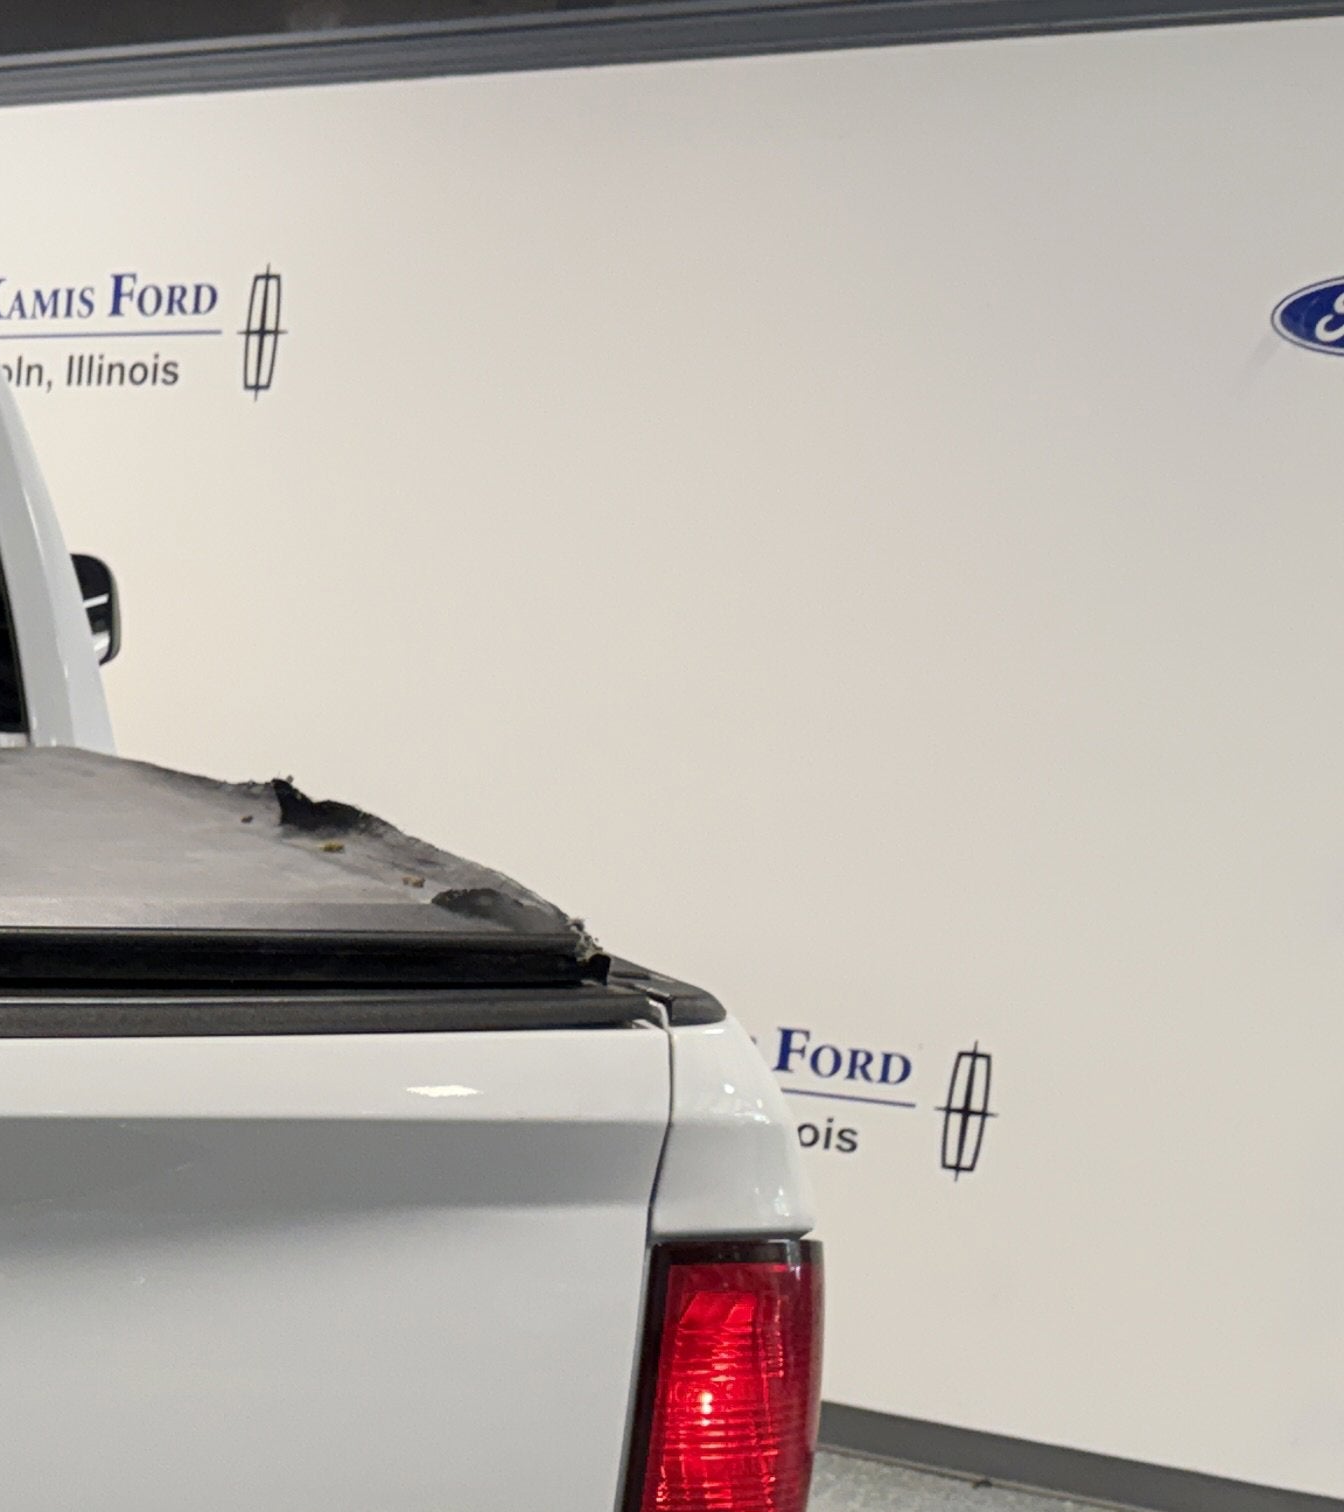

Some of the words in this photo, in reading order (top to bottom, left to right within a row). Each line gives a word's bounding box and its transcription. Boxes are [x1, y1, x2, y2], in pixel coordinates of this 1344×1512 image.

[108, 273, 219, 318] FORD
[66, 353, 180, 387] Illinois
[772, 1026, 913, 1086] FORD
